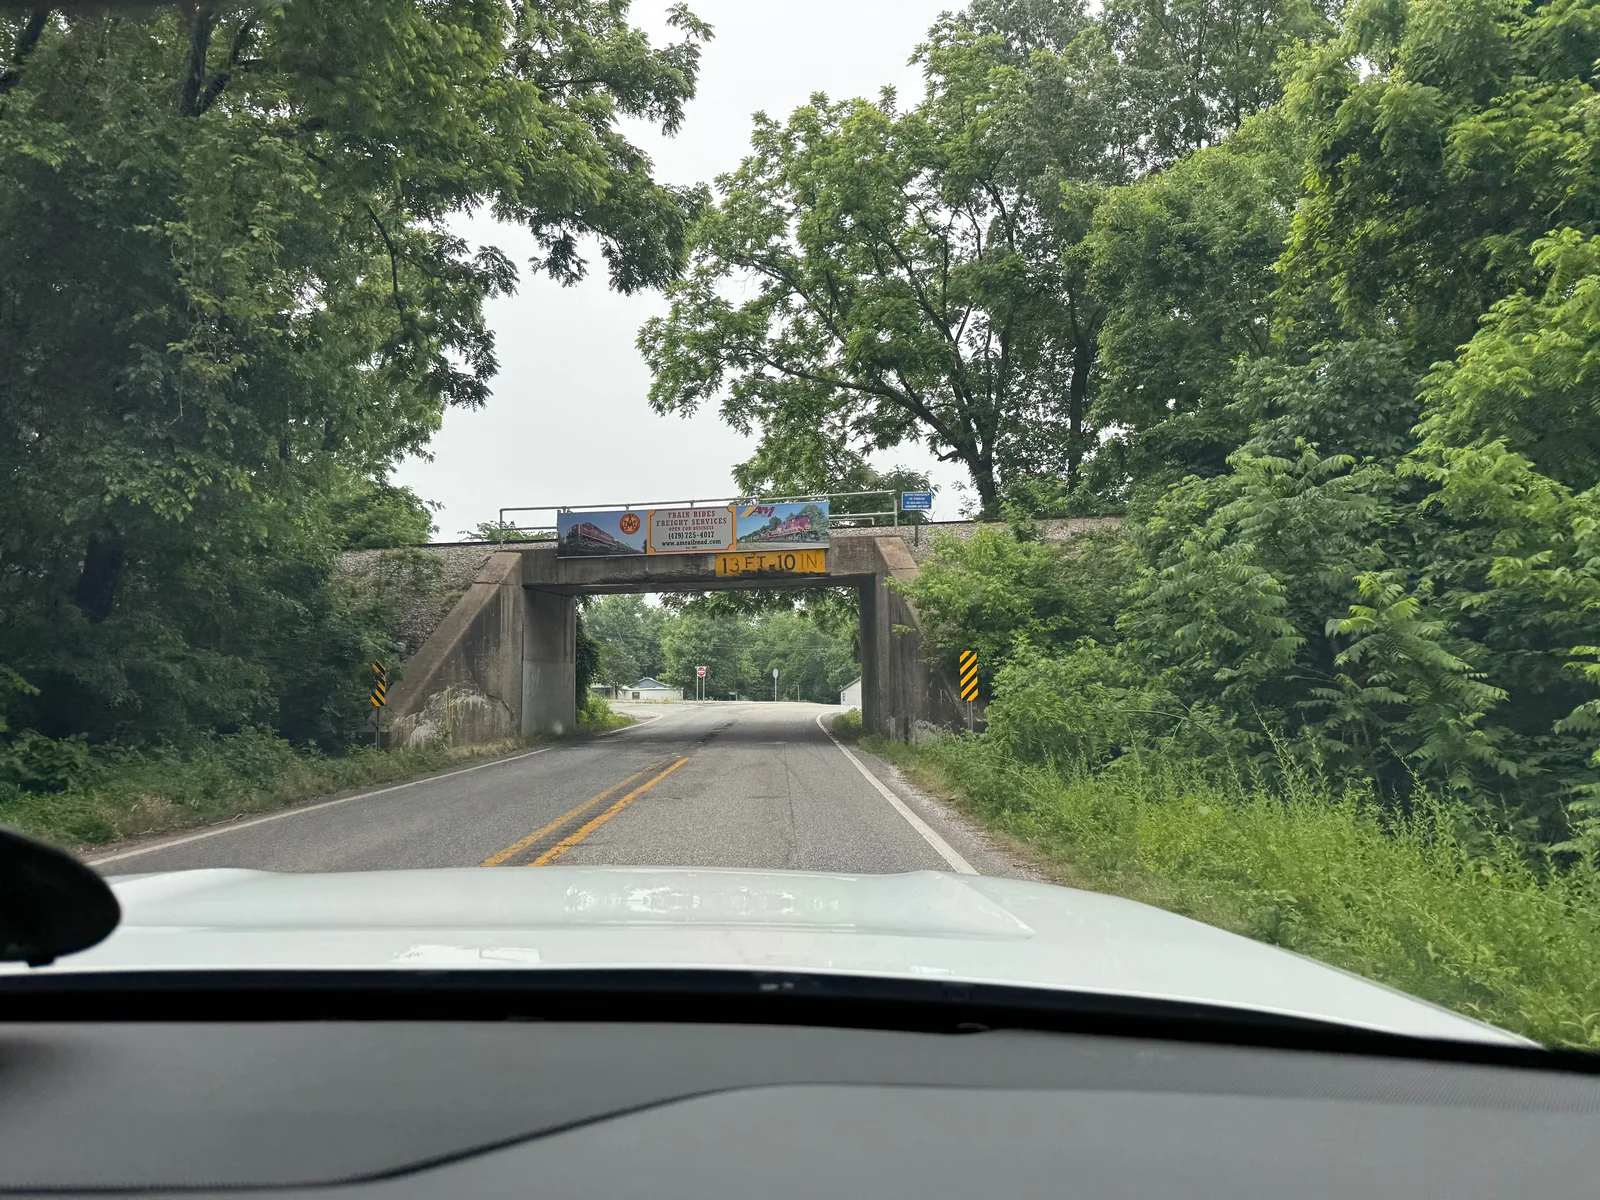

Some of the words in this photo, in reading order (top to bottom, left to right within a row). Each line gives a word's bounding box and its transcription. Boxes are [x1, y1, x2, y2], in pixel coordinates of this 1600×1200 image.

[667, 511, 690, 519] TRAIN
[693, 510, 716, 518] RIDES
[656, 519, 688, 527] FREIGHT
[691, 517, 727, 526] SERVICES
[661, 539, 722, 547] www.amrailroad.com
[722, 557, 740, 574] 13
[800, 553, 817, 570] IN
